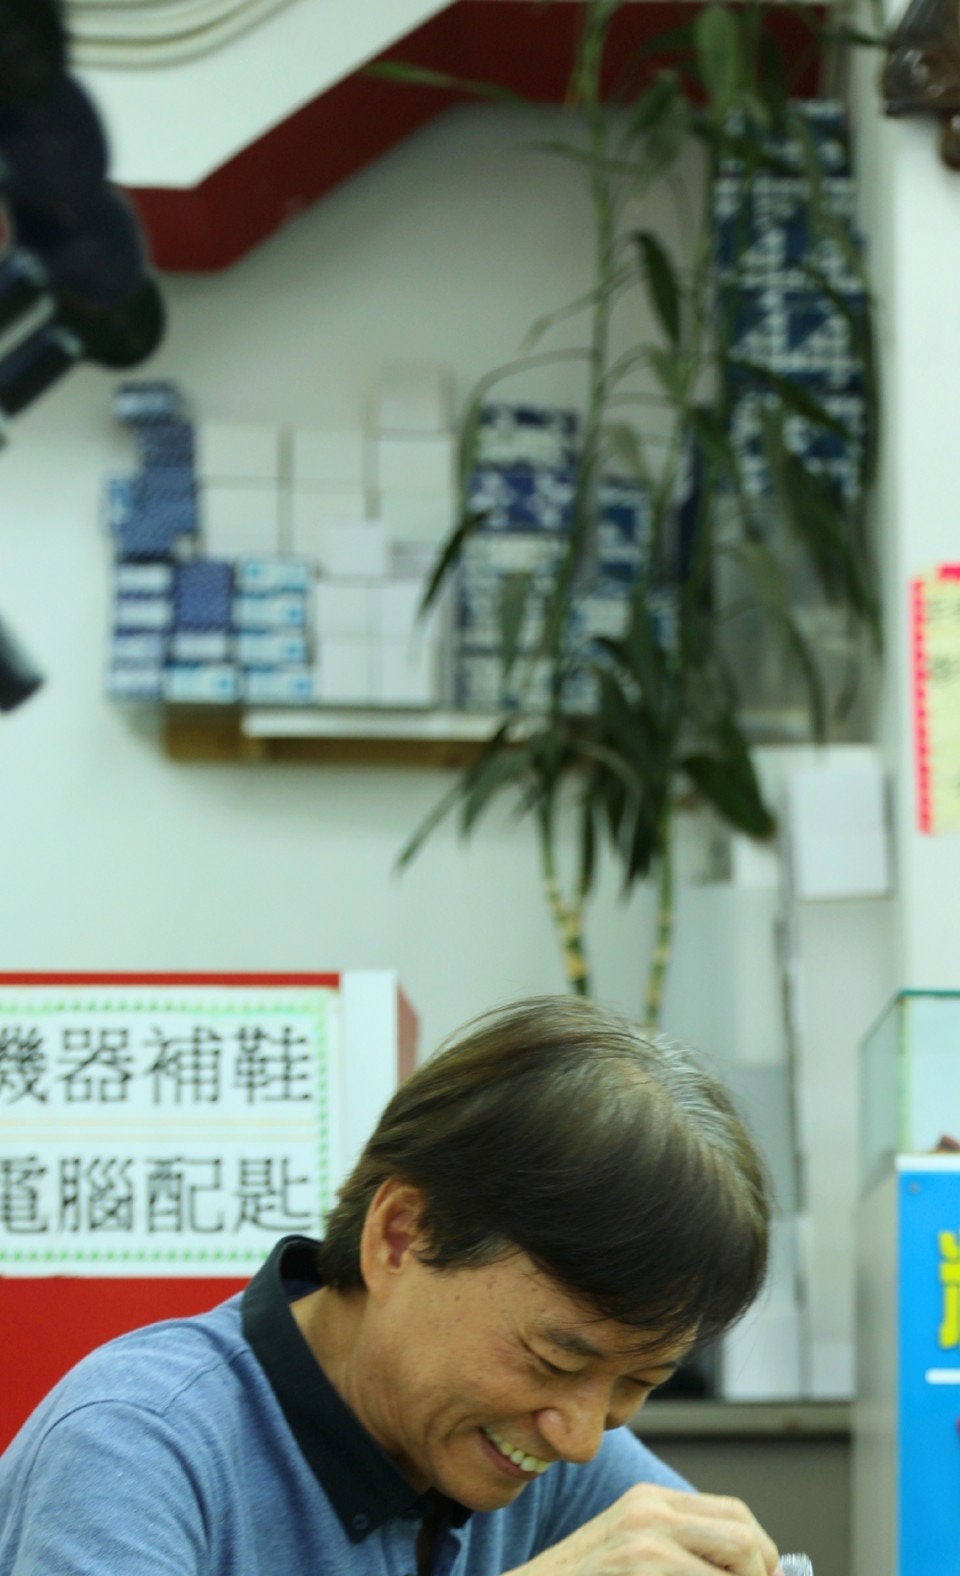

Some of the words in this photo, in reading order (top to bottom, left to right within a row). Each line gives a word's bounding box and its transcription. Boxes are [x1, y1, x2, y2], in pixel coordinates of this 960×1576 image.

[0, 1025, 313, 1105] 機器補鞋
[0, 1154, 313, 1236] 電腦配匙
